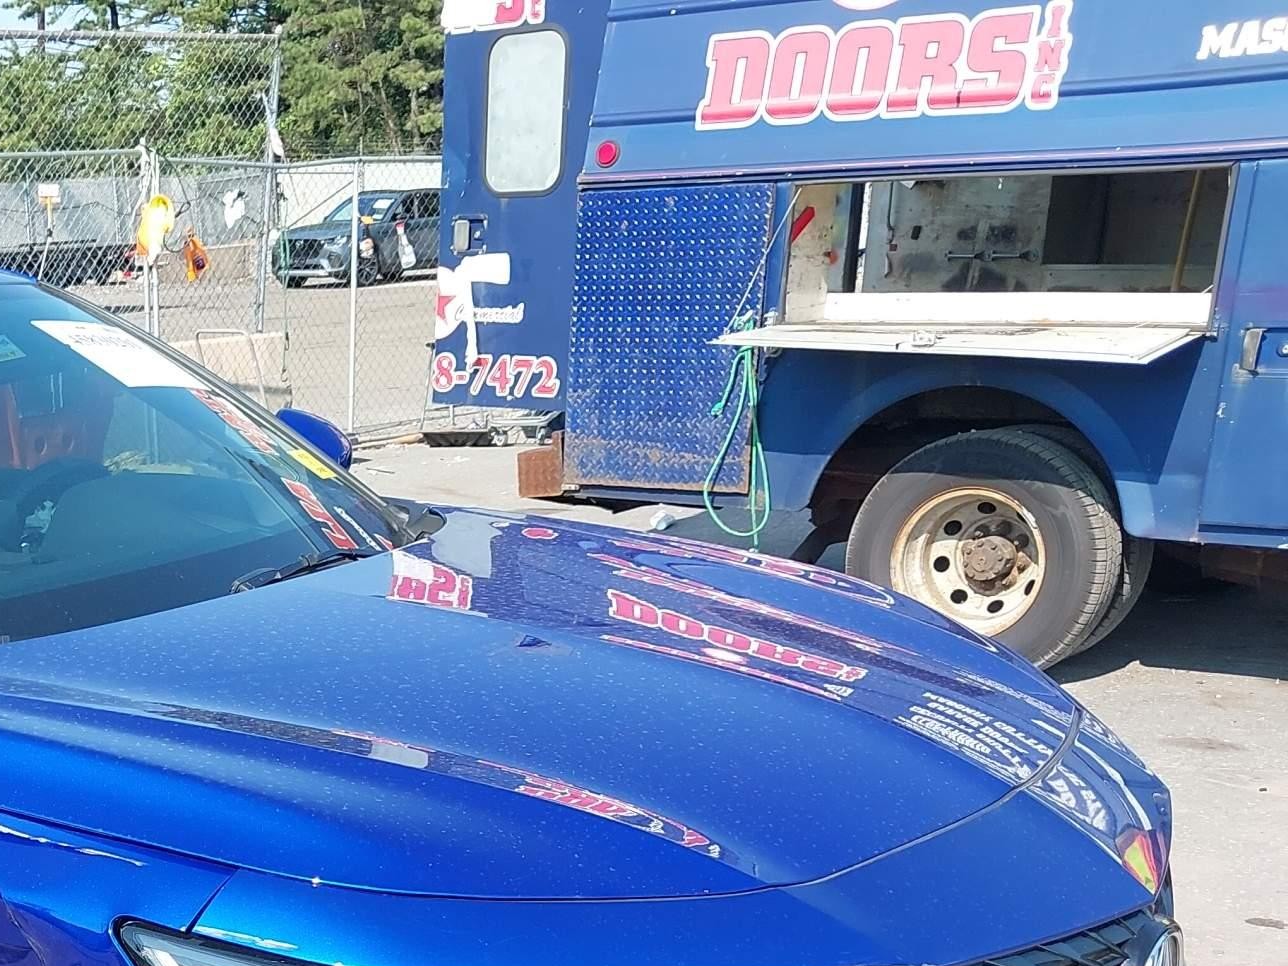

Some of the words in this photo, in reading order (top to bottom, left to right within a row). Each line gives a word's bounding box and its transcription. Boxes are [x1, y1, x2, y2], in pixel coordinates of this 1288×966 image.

[698, 10, 1036, 127] DOORS
[1029, 4, 1067, 105] INC
[1196, 16, 1288, 60] MAS
[433, 354, 559, 396] 8-7472
